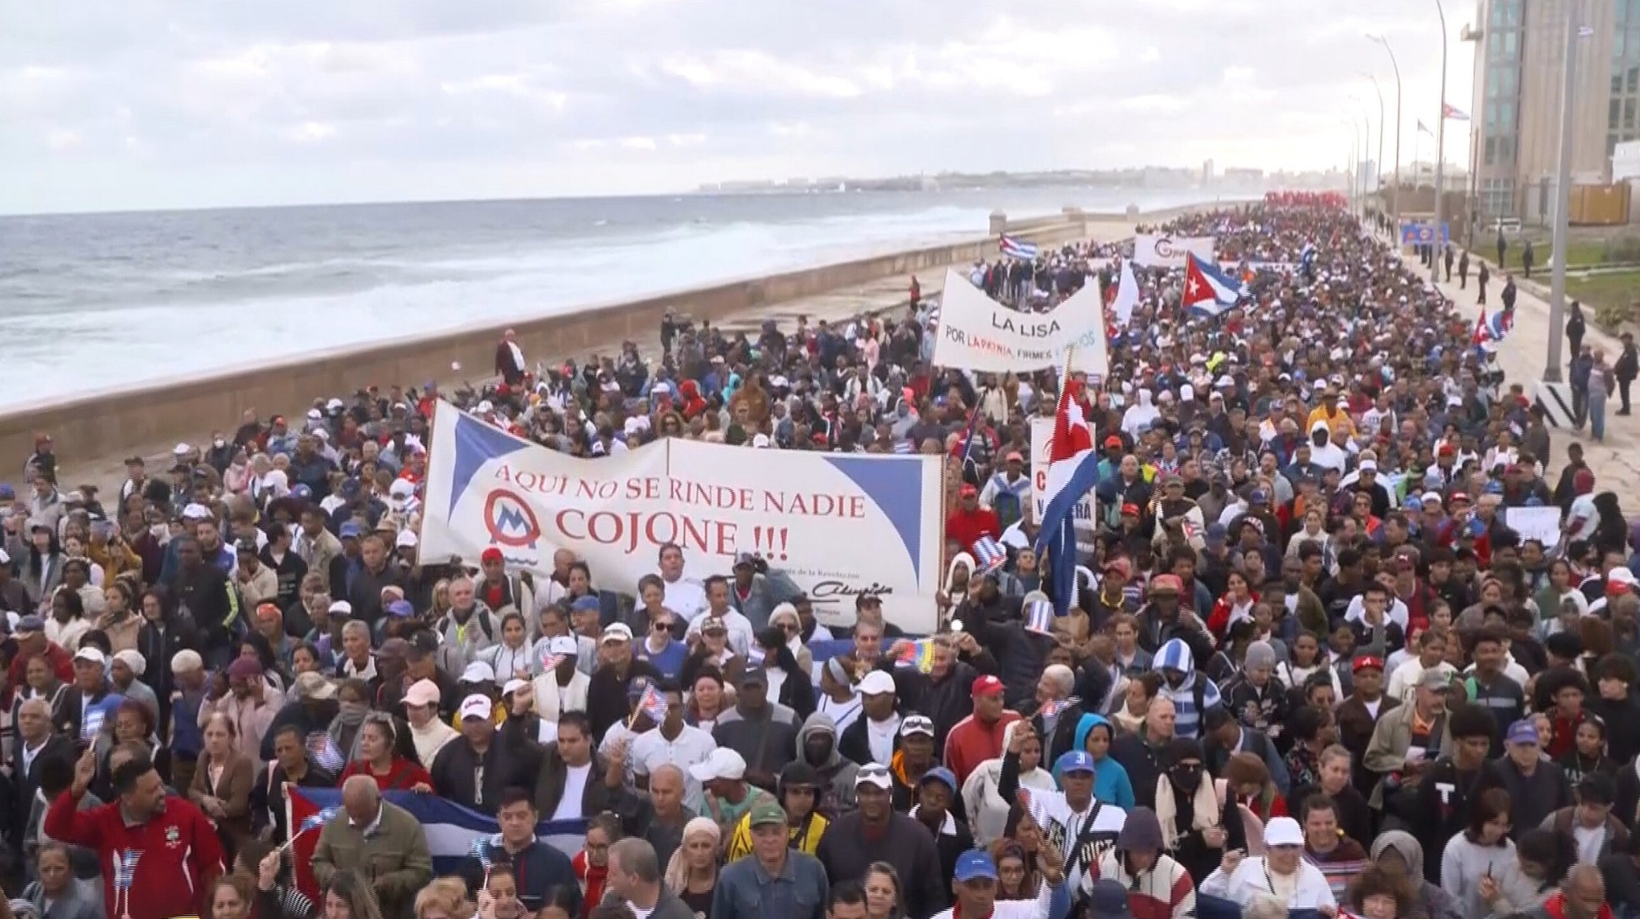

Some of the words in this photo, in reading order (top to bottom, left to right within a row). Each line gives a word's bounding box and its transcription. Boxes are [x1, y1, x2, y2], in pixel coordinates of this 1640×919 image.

[946, 325, 965, 345] POR
[992, 312, 1015, 333] LA
[1020, 319, 1061, 338] LISA
[576, 479, 618, 499] NO
[626, 477, 660, 499] SE
[669, 478, 754, 511] RINDE
[764, 490, 866, 518] NADIE
[556, 508, 738, 556] COJONE
